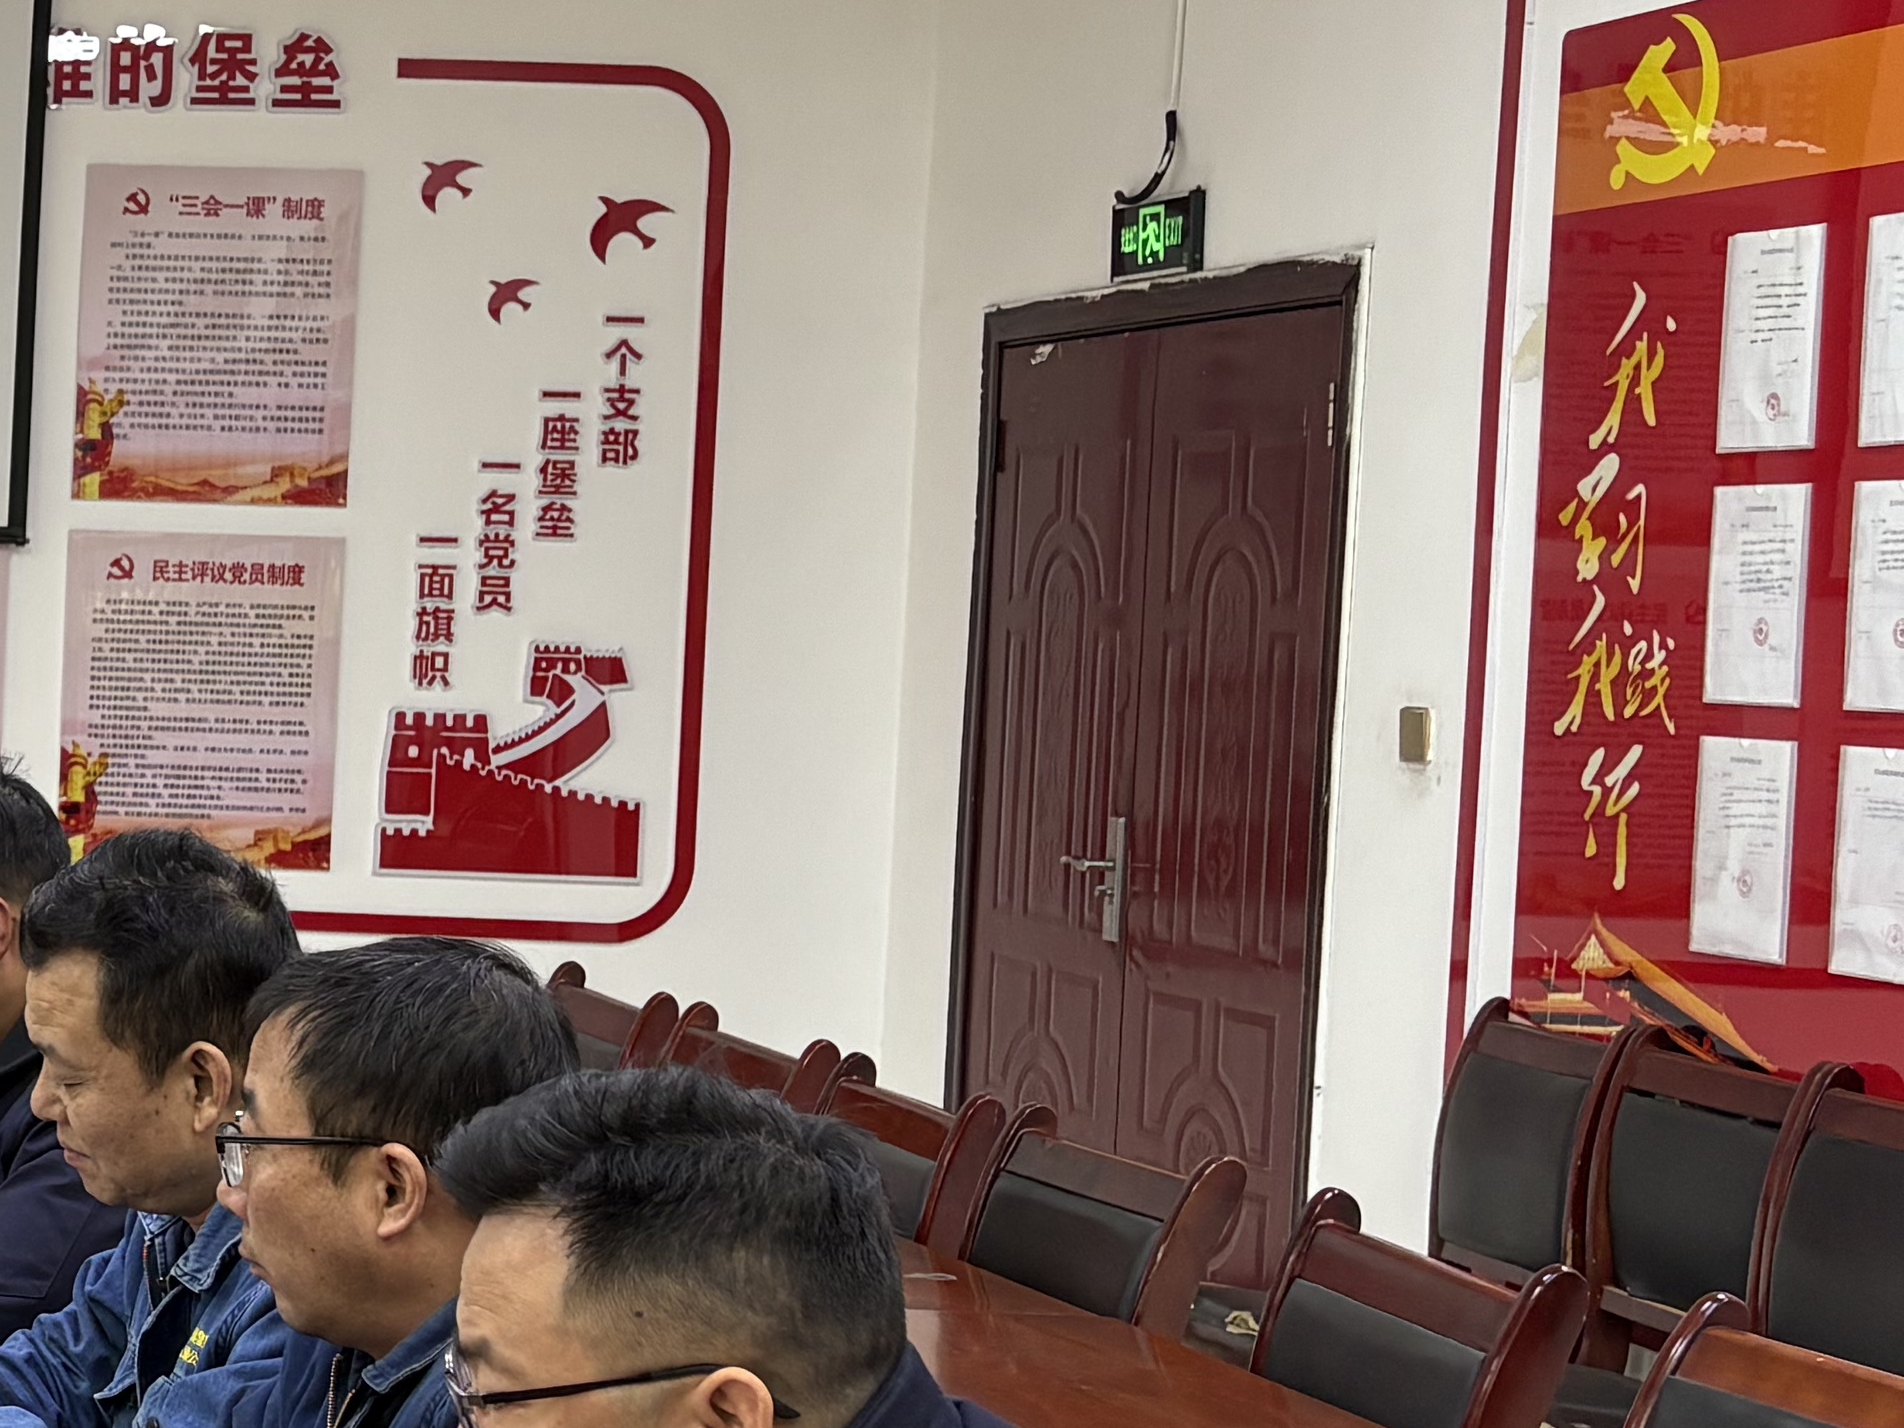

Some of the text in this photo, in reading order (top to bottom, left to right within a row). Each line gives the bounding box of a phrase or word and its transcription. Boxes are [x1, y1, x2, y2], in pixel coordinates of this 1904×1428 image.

[169, 194, 326, 222] “三会一课”制度
[1165, 215, 1183, 247] EXIT
[601, 315, 645, 465] 一个支部
[477, 461, 522, 613] 一名党员
[537, 391, 582, 540] 一座堡垒
[151, 558, 306, 588] 民主评议党员制度
[411, 535, 459, 688] 一面旗帜
